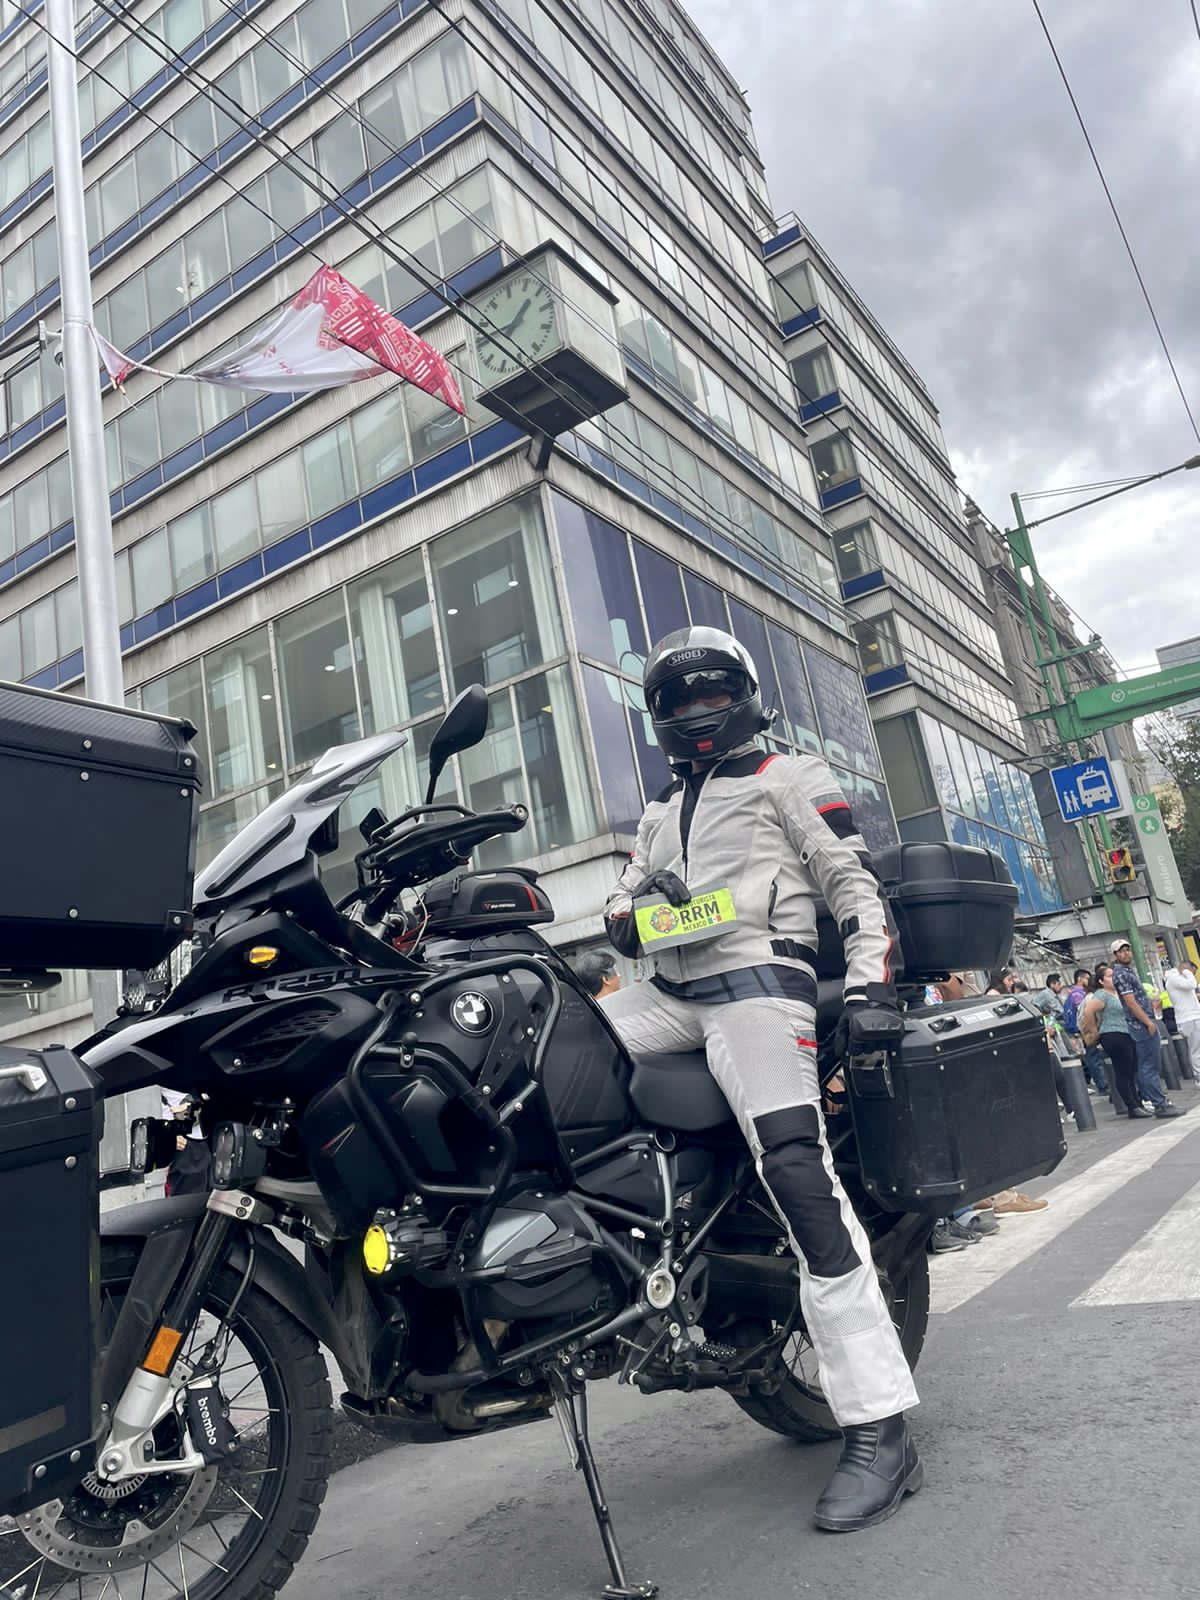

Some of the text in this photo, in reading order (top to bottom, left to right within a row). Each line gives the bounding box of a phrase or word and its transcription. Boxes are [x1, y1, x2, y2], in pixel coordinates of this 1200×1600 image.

[671, 649, 702, 664] SHOEI
[680, 901, 720, 925] RRM
[198, 1396, 216, 1445] brembo
